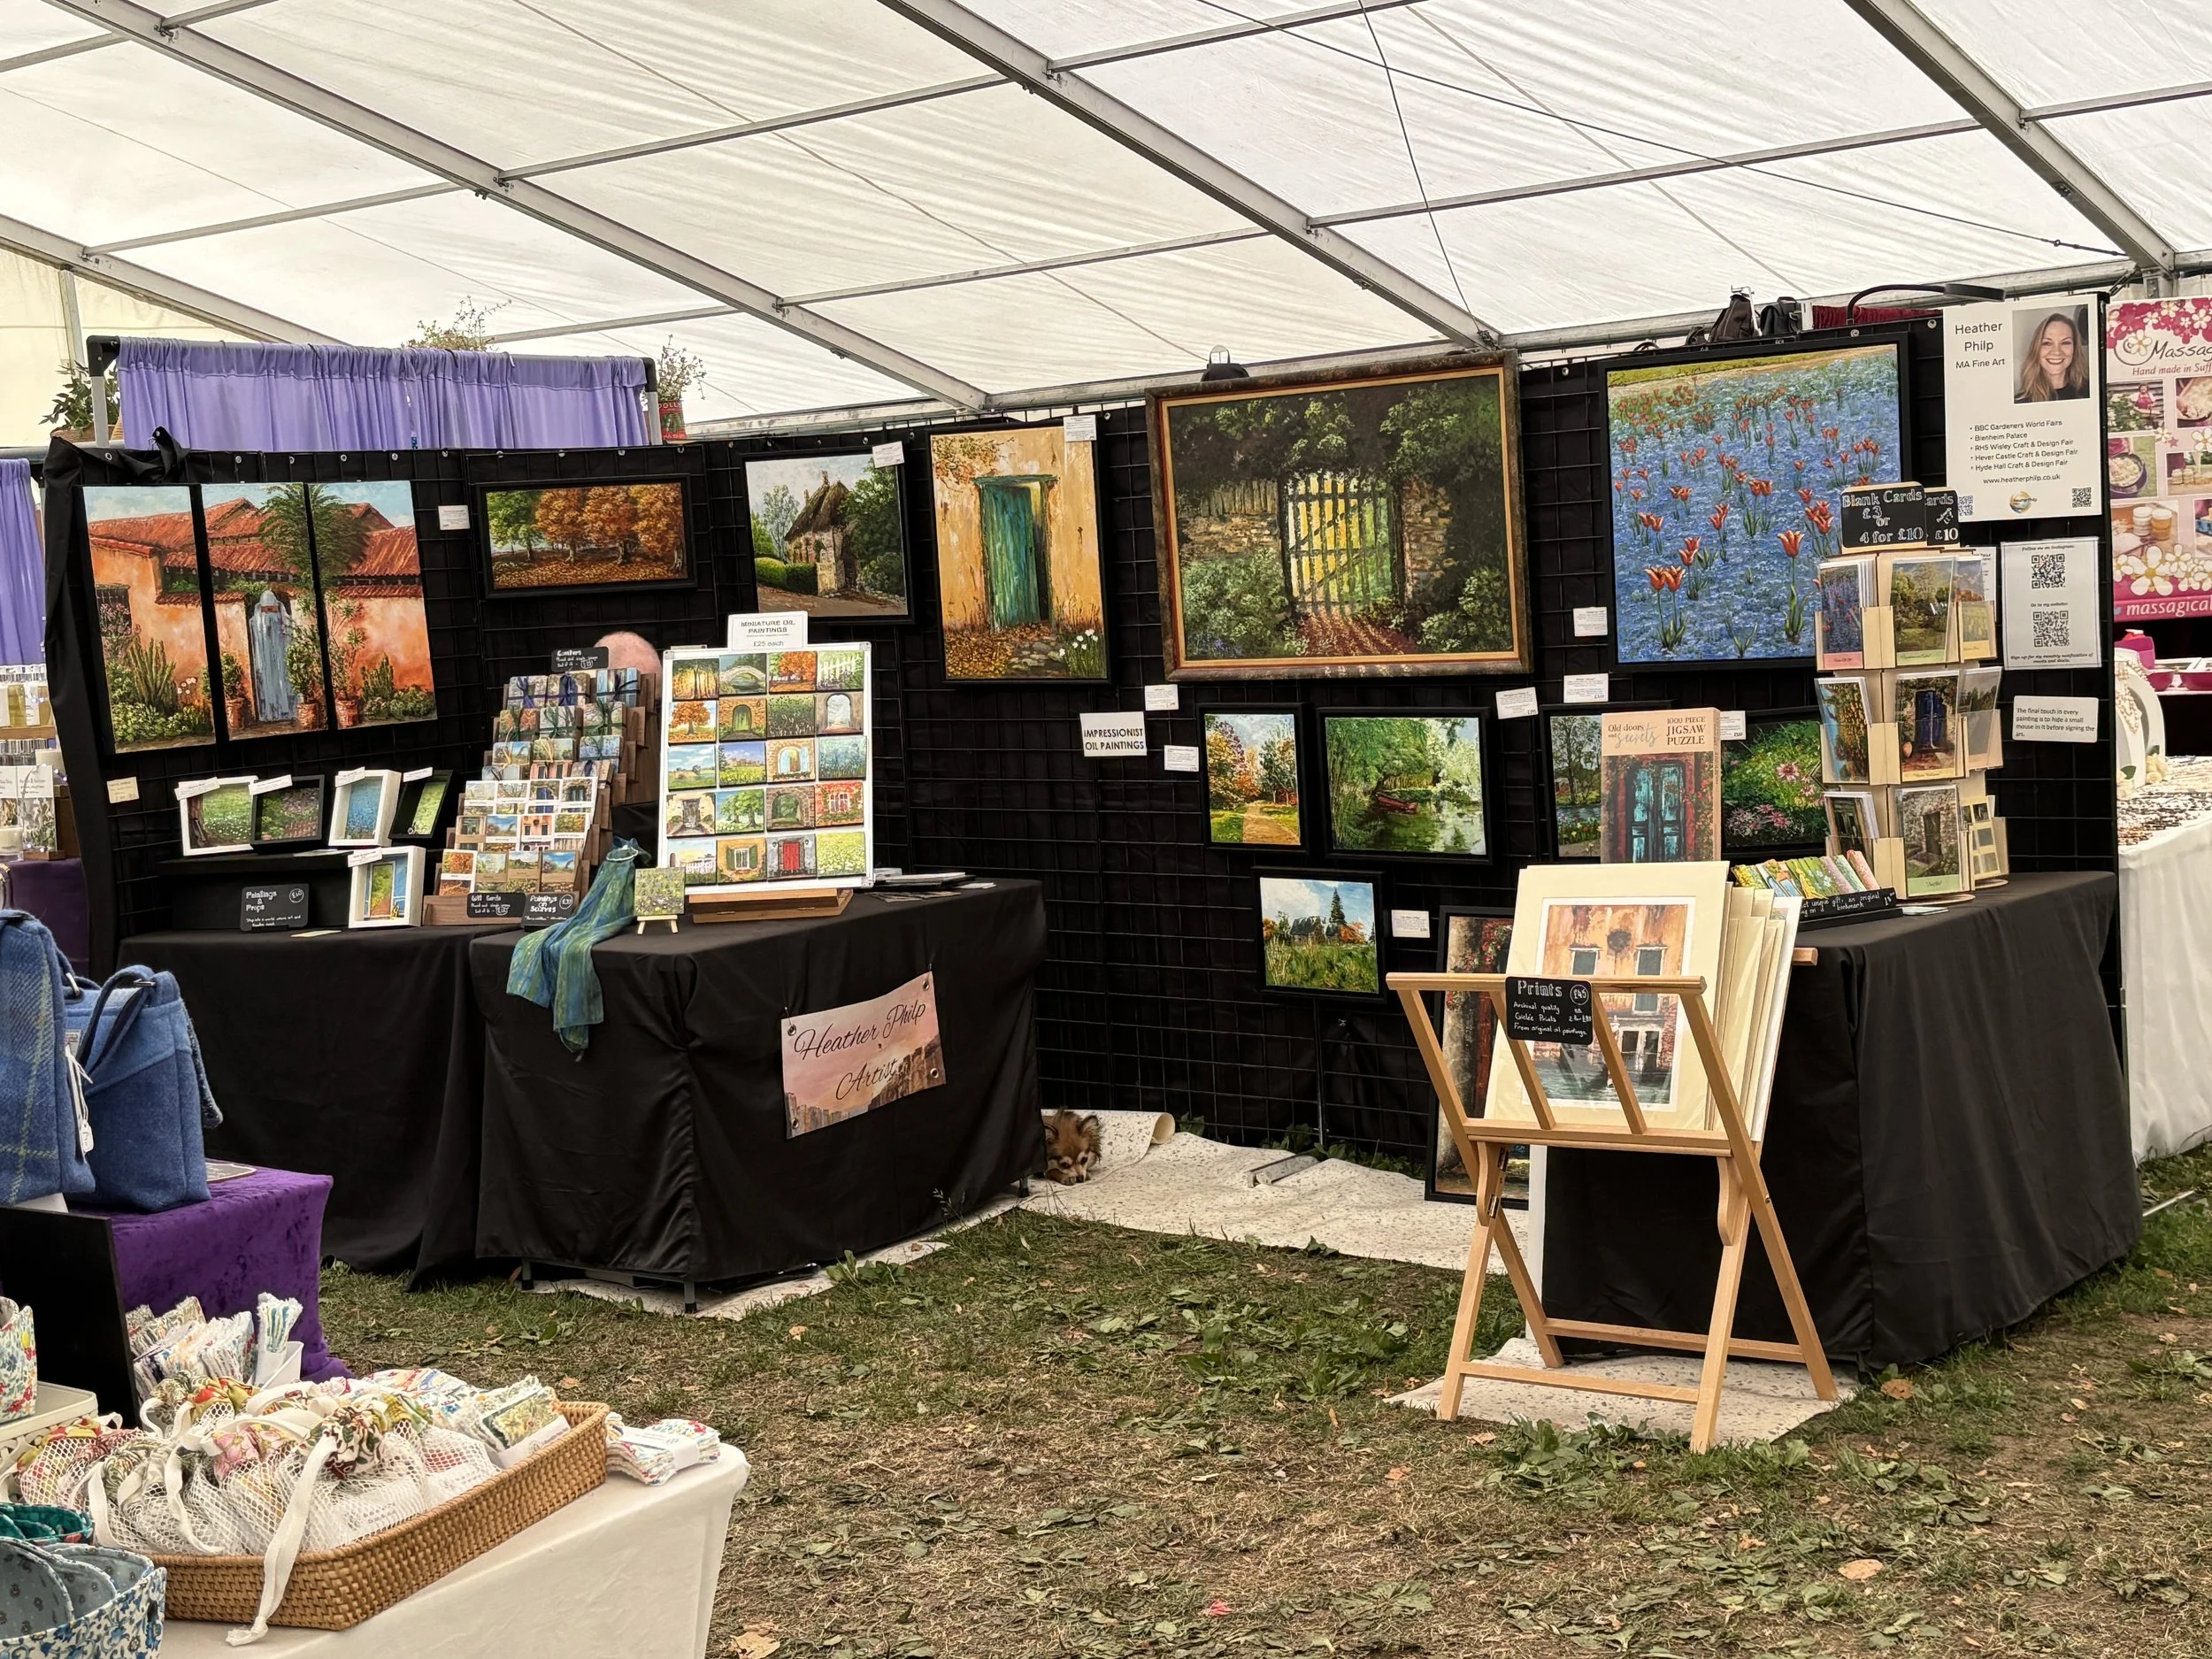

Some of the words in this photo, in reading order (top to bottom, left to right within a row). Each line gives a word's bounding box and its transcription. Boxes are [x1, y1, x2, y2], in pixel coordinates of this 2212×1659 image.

[1955, 322, 2003, 334] Heather
[1964, 340, 1994, 352] Philp
[1972, 359, 1990, 368] Fine
[2132, 365, 2156, 376] Hand
[2158, 365, 2181, 373] made
[2194, 362, 2212, 375] Suff
[2041, 449, 2064, 458] Design
[1983, 474, 2061, 484] www.heatherphilp.co.uk
[1841, 492, 1881, 508] Blank
[1883, 488, 1924, 503] Cards
[1924, 493, 1954, 506] ards
[1862, 505, 1883, 519] £3
[1876, 516, 1890, 527] or
[1859, 531, 1870, 543] 4
[1871, 530, 1893, 543] for
[1897, 526, 1924, 541] £10
[1934, 527, 1959, 541] £10
[1083, 727, 1143, 738] IMPRESSIONIST
[1608, 724, 1622, 733] Old
[1623, 723, 1644, 732] doors
[1665, 724, 1706, 736] JIGSAW
[1615, 722, 1660, 749] secrets
[1666, 735, 1706, 746] PUZZLE
[1085, 741, 1099, 750] OIL
[1101, 740, 1145, 750] PAINTINGS
[246, 890, 277, 901] Paintings
[1860, 892, 1879, 903] original
[246, 904, 265, 913] Props
[1836, 901, 1864, 911] bookmark
[1517, 980, 1563, 997] Prints
[1573, 988, 1586, 1000] £45
[1513, 1001, 1537, 1010] Archival
[1540, 1004, 1560, 1015] quality
[1539, 1014, 1557, 1023] Prints
[794, 1023, 879, 1061] Heather
[882, 999, 926, 1039] Philp
[1514, 1022, 1529, 1032] From
[1531, 1025, 1553, 1034] original
[835, 1057, 898, 1101] Artist
